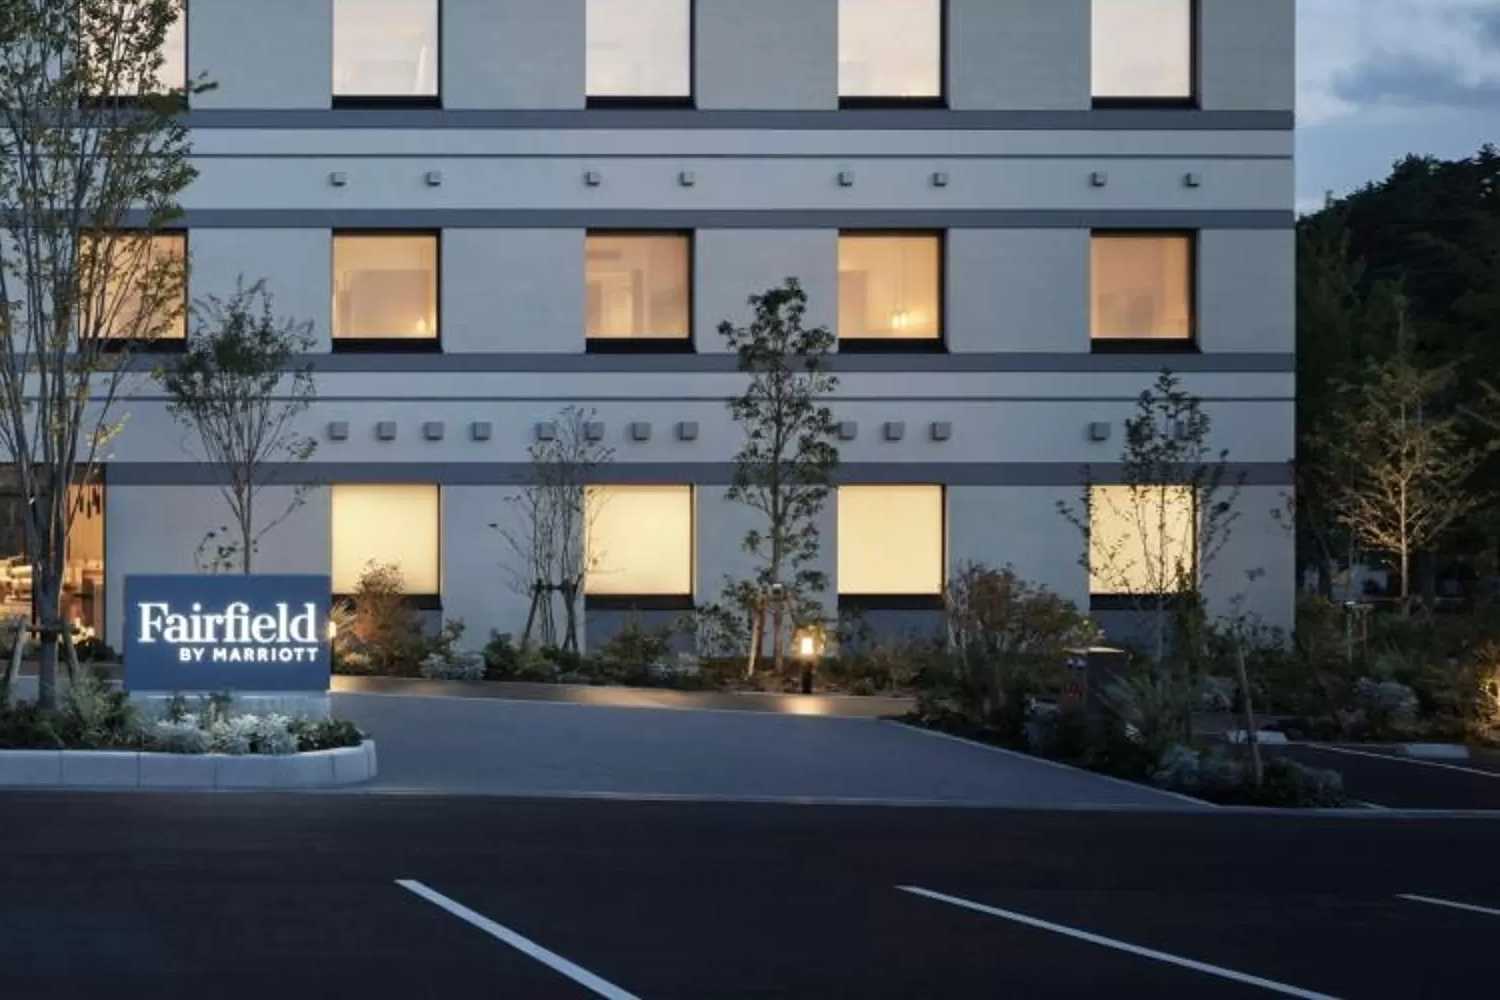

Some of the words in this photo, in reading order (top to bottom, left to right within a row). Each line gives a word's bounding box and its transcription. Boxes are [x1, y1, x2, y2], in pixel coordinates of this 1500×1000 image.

[137, 601, 319, 643] Fairfield
[179, 647, 204, 662] BY
[212, 647, 319, 662] MARRIOTT
